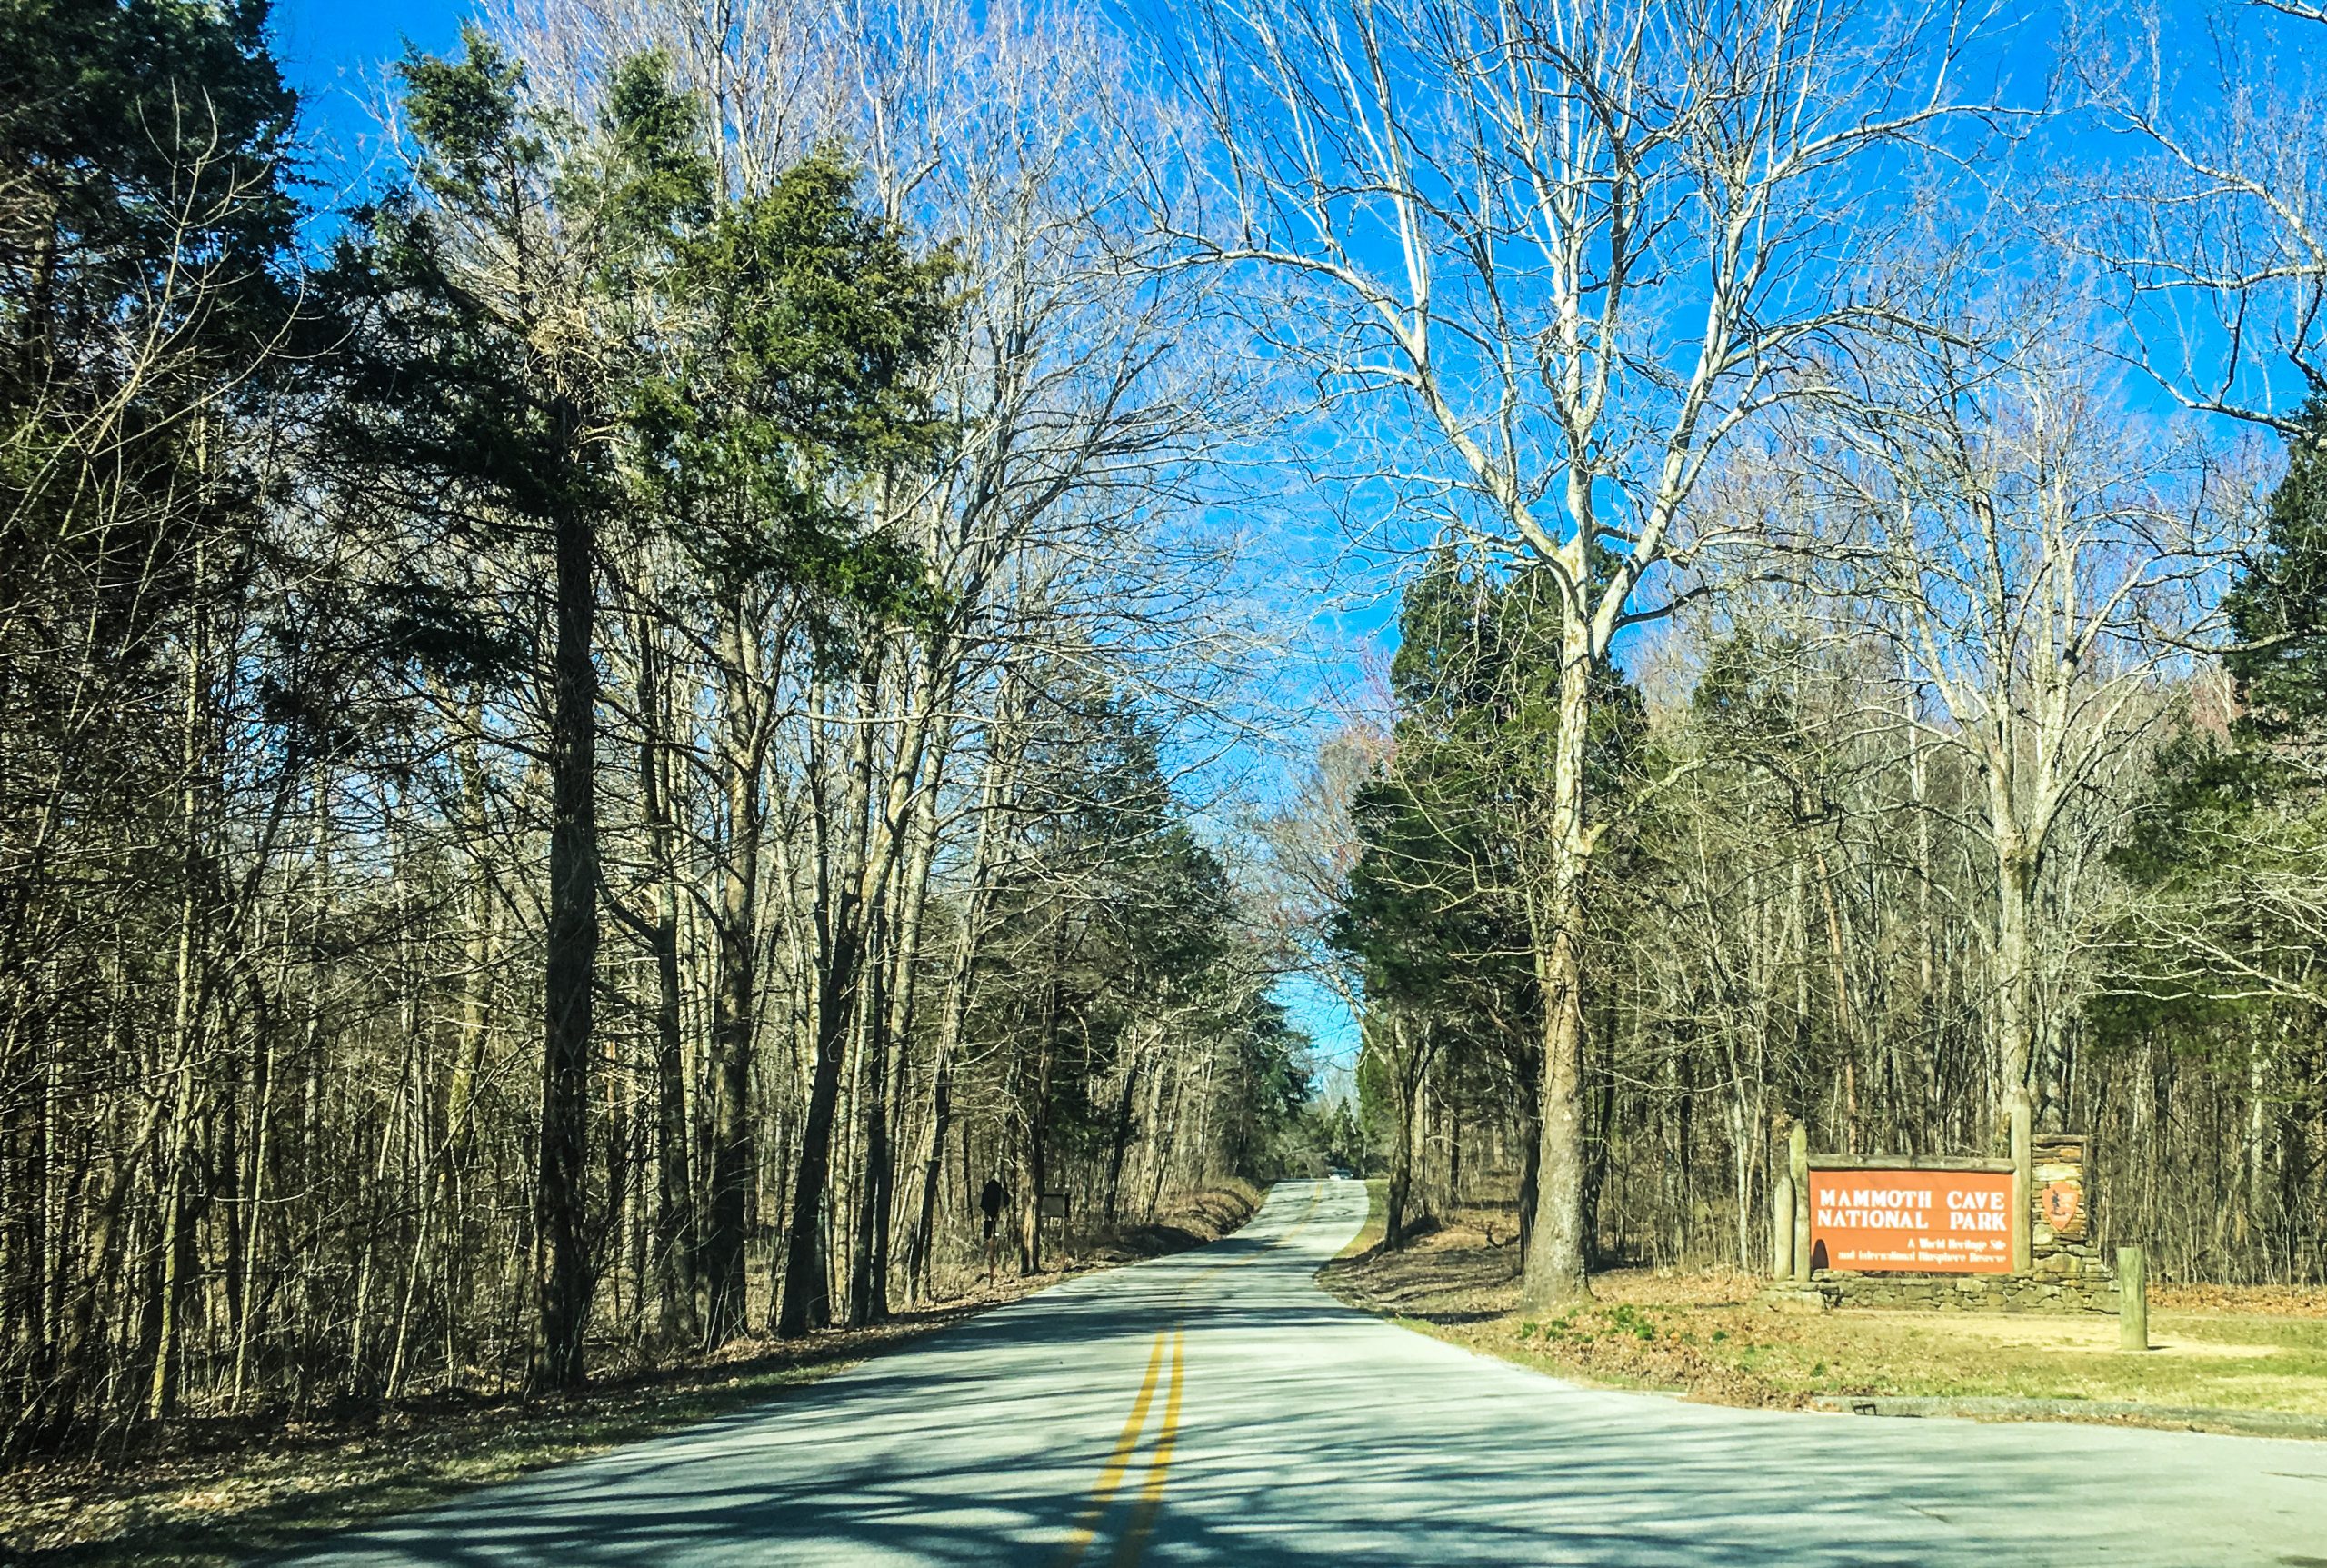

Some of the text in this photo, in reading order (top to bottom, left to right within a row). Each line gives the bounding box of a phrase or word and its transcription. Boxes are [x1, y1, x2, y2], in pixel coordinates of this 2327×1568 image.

[1820, 1189, 2005, 1210] MAMMOTH CAVE
[1817, 1209, 2007, 1231] NATIONAL PARK
[1907, 1238, 1915, 1249] A
[1919, 1237, 1946, 1249] World
[1948, 1238, 1987, 1252] Heritage
